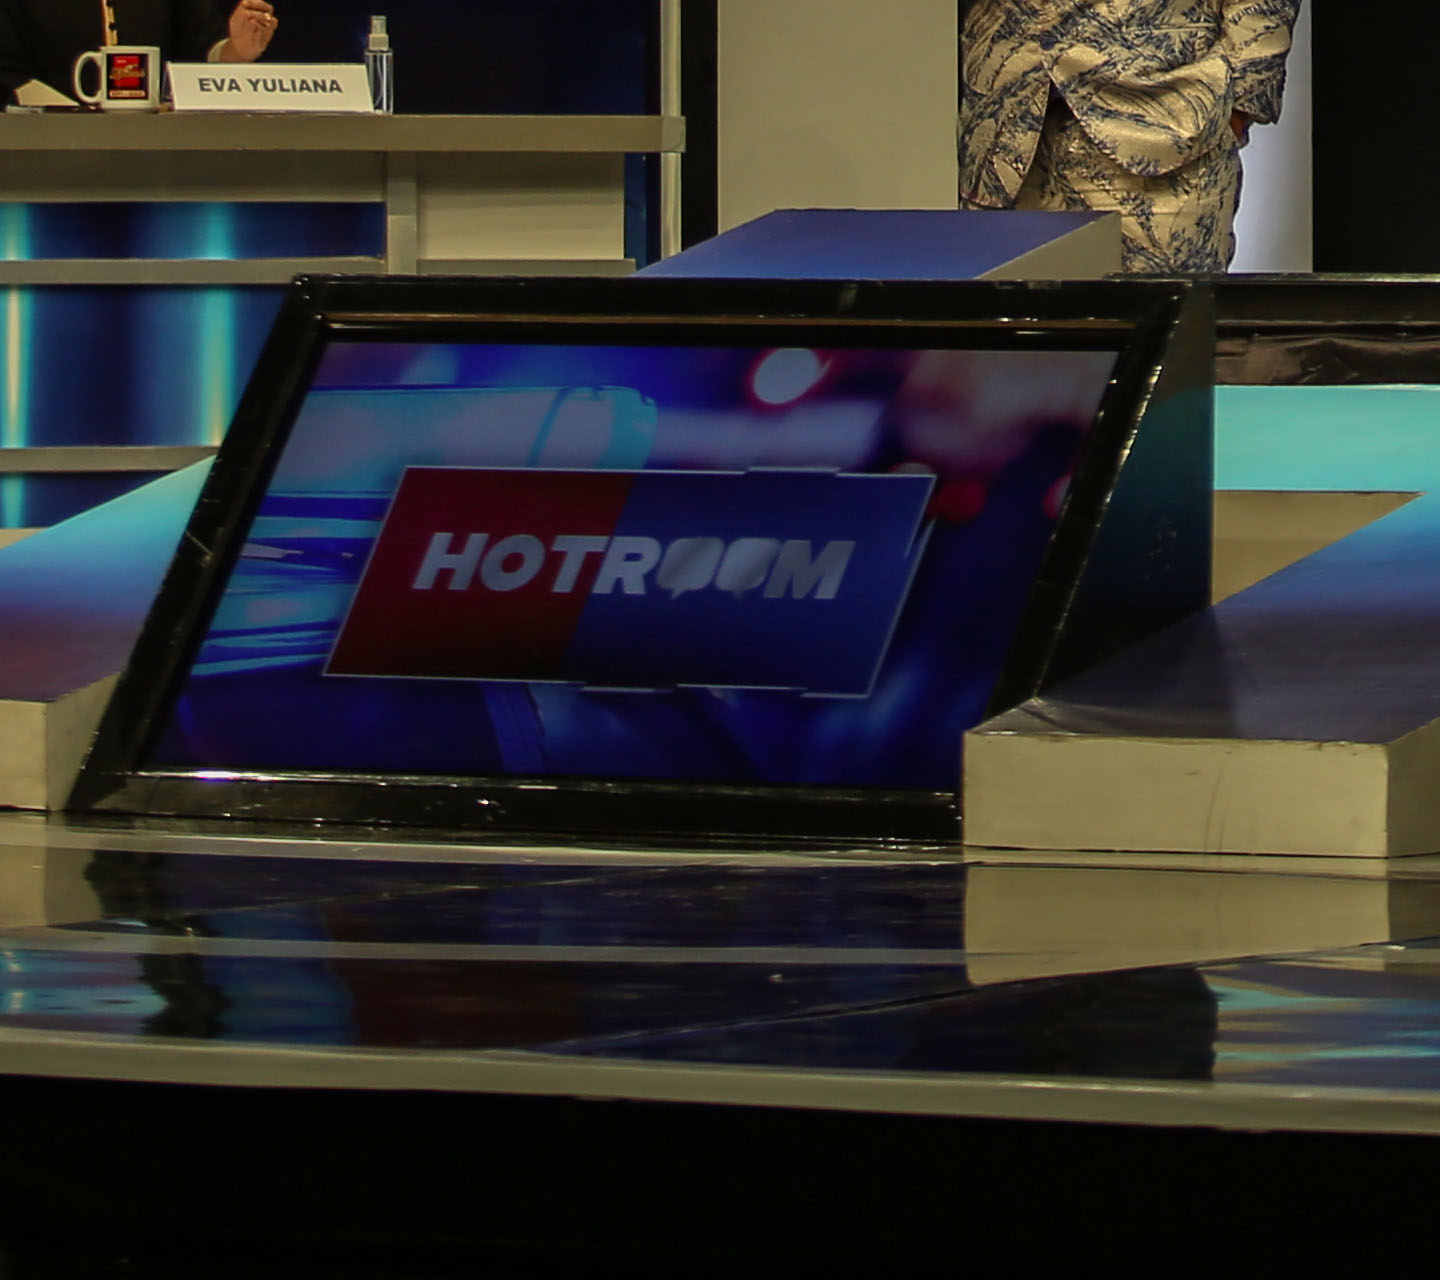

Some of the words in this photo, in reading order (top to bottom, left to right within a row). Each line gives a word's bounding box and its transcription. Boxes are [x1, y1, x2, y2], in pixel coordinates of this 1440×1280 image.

[198, 77, 242, 92] EVA
[246, 78, 343, 94] YULIANA
[412, 531, 855, 601] HOTROOM
